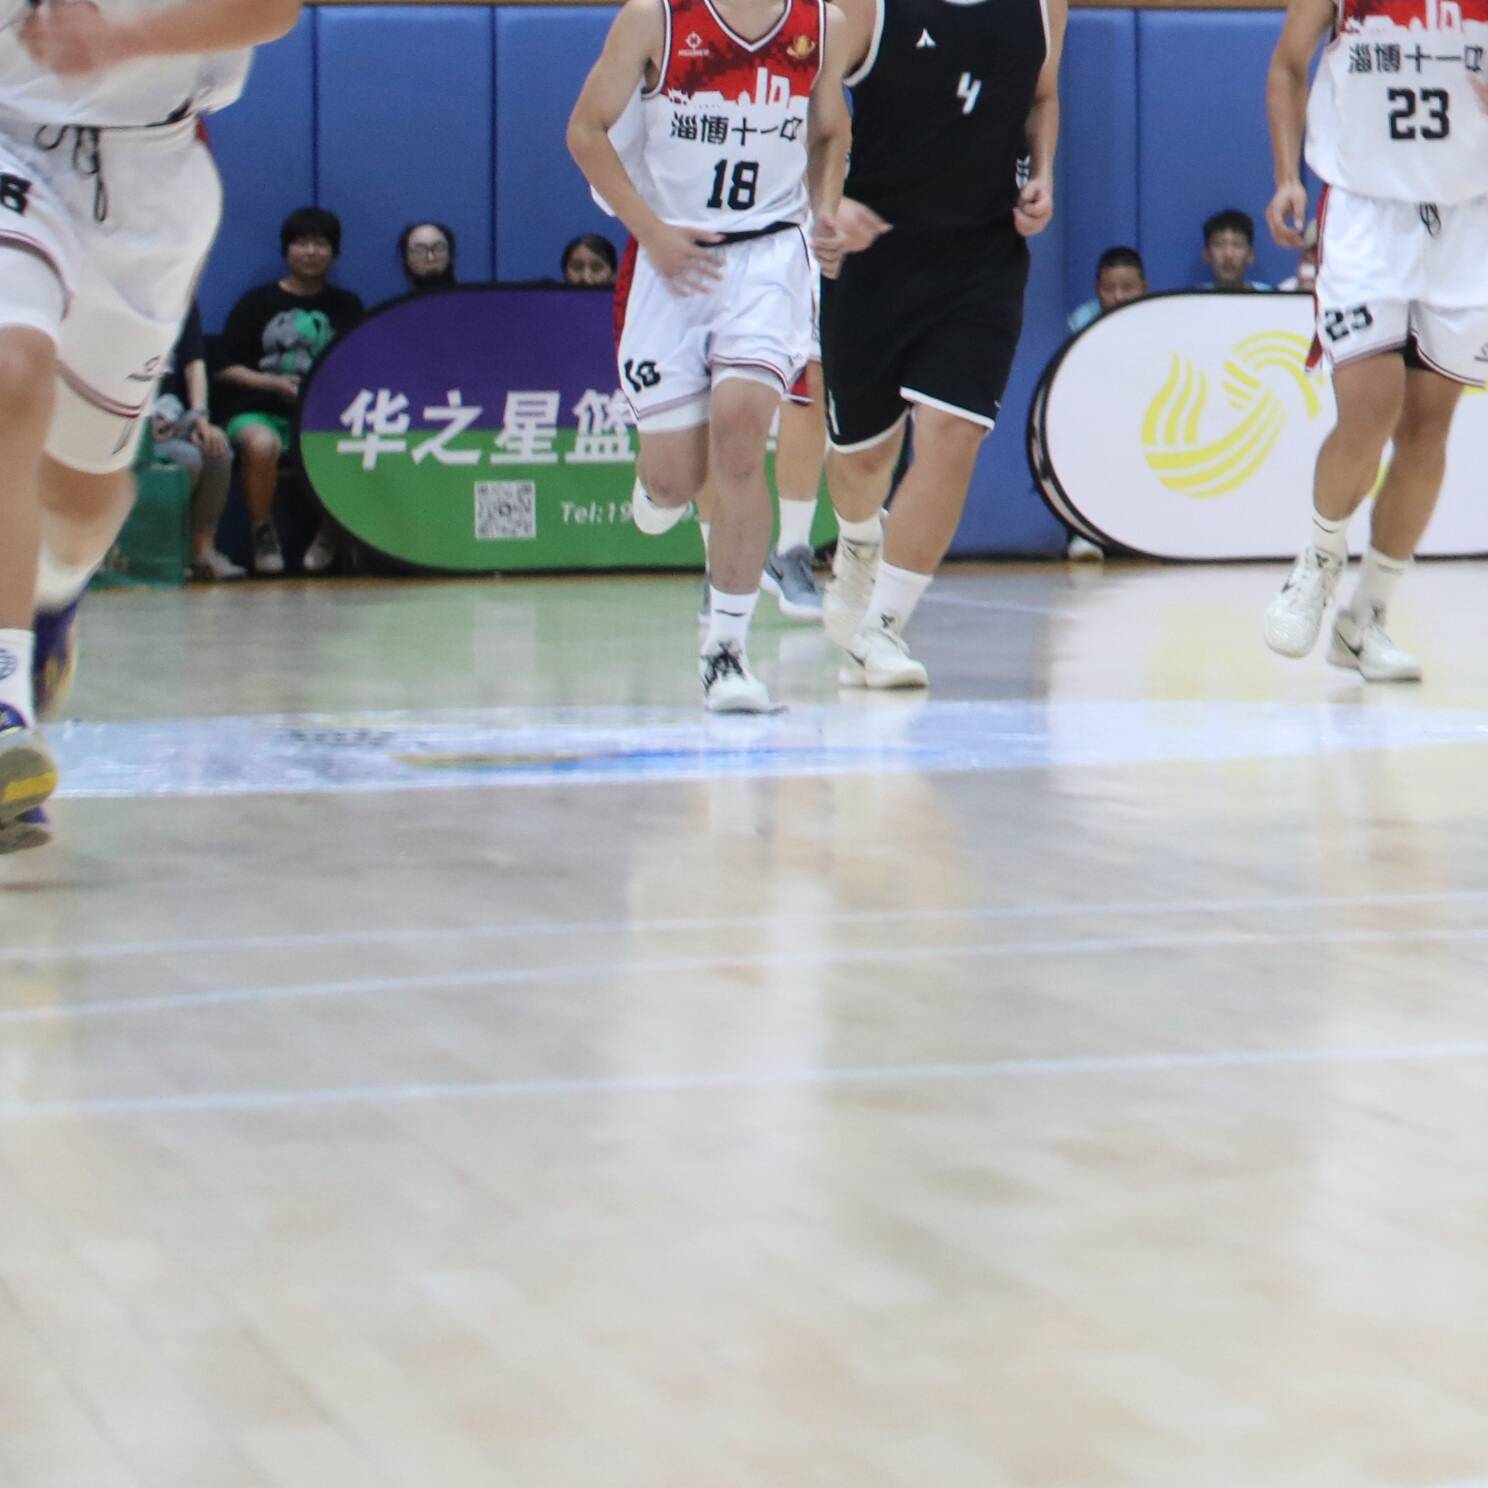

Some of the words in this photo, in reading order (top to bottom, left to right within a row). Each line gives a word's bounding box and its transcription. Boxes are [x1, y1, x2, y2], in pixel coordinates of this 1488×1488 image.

[1348, 43, 1484, 74] 淄博十一中
[957, 71, 982, 114] 4
[1387, 87, 1449, 140] 23
[670, 111, 804, 146] 淄博十一中
[706, 158, 760, 211] 18
